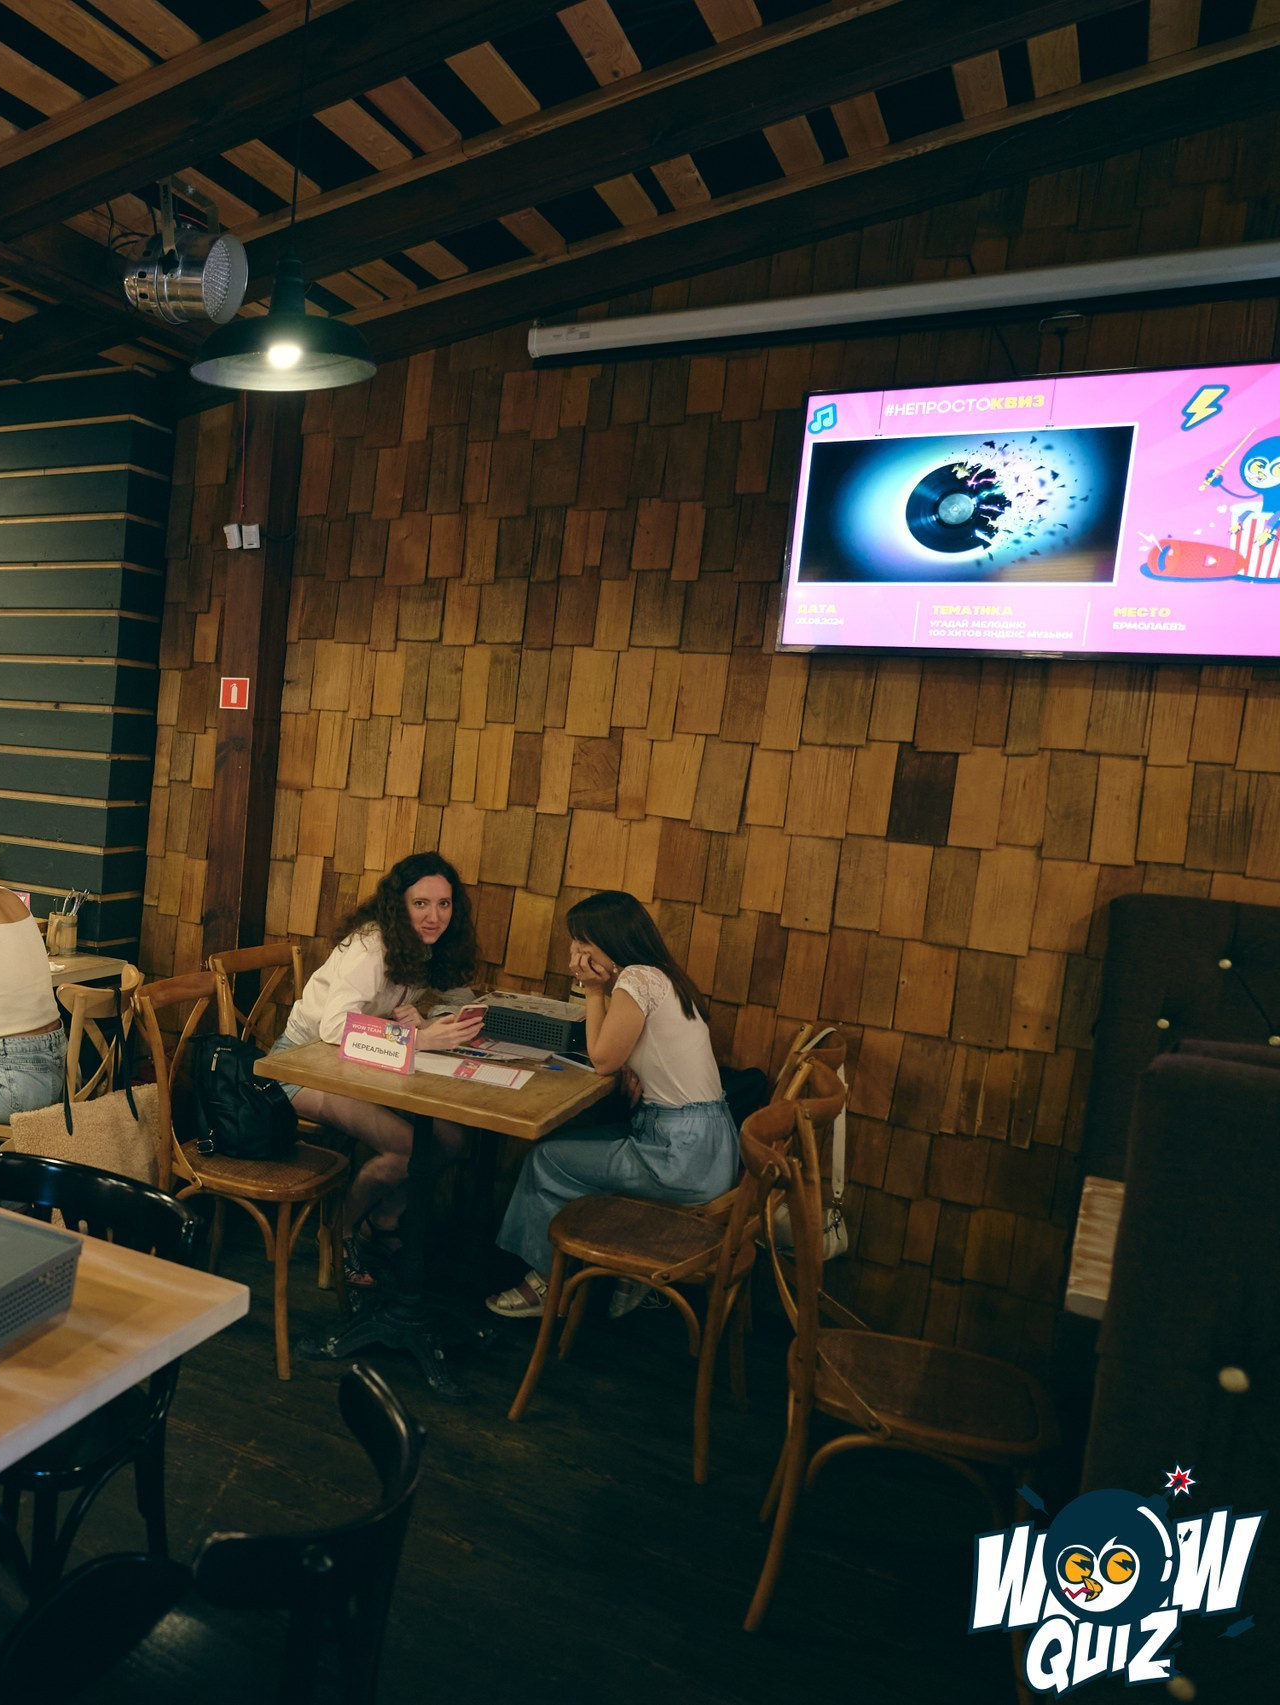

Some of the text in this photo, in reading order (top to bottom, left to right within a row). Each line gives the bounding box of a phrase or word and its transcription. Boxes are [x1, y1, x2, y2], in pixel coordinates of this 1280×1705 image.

[884, 394, 1045, 417] #НЕПРОСТОКВИЗ
[797, 603, 837, 614] ДАТА
[932, 605, 1013, 616] ТЕМАТИКА
[1113, 607, 1171, 618] МЕСТО
[929, 618, 1027, 629] УГАДАЙ МЕЛОДИЮ
[928, 629, 946, 637] 100
[948, 629, 982, 638] ХИТОВ
[1026, 631, 1074, 640] МУЗЫКИ
[352, 1042, 400, 1058] НЕРЕАЛЬНЫЕ
